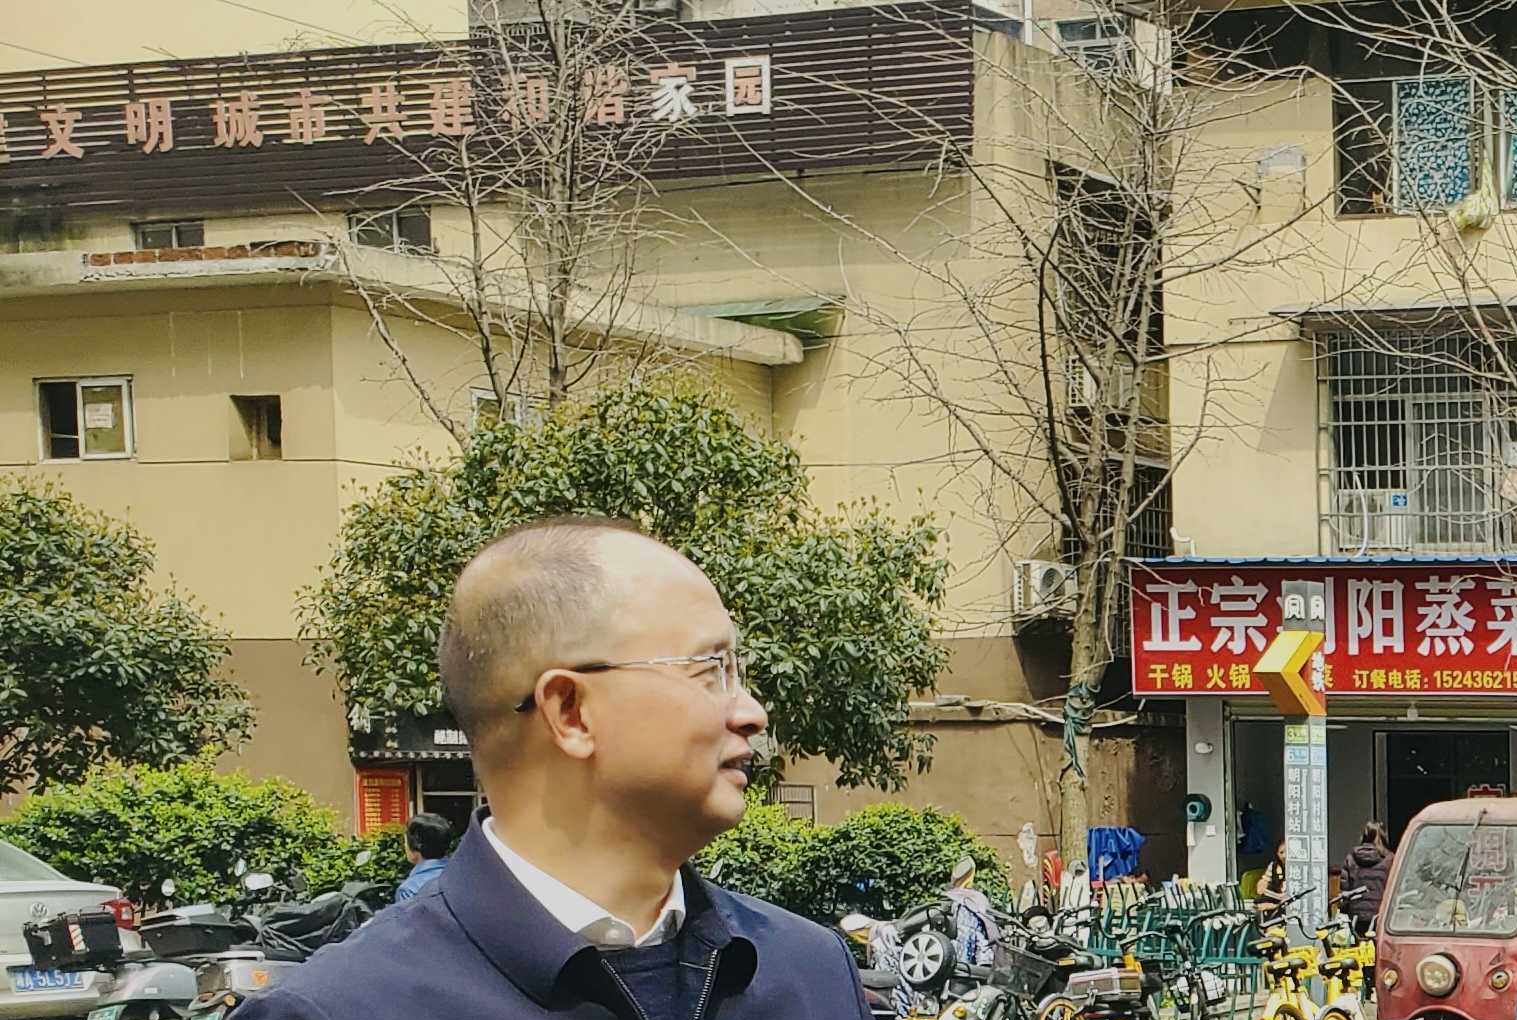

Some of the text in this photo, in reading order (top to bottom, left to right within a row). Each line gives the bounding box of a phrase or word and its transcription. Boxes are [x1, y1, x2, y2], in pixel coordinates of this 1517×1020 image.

[0, 55, 771, 163] 文明城市共建和谐家园
[1147, 664, 1193, 689] 干锅
[1206, 664, 1251, 689] 火锅
